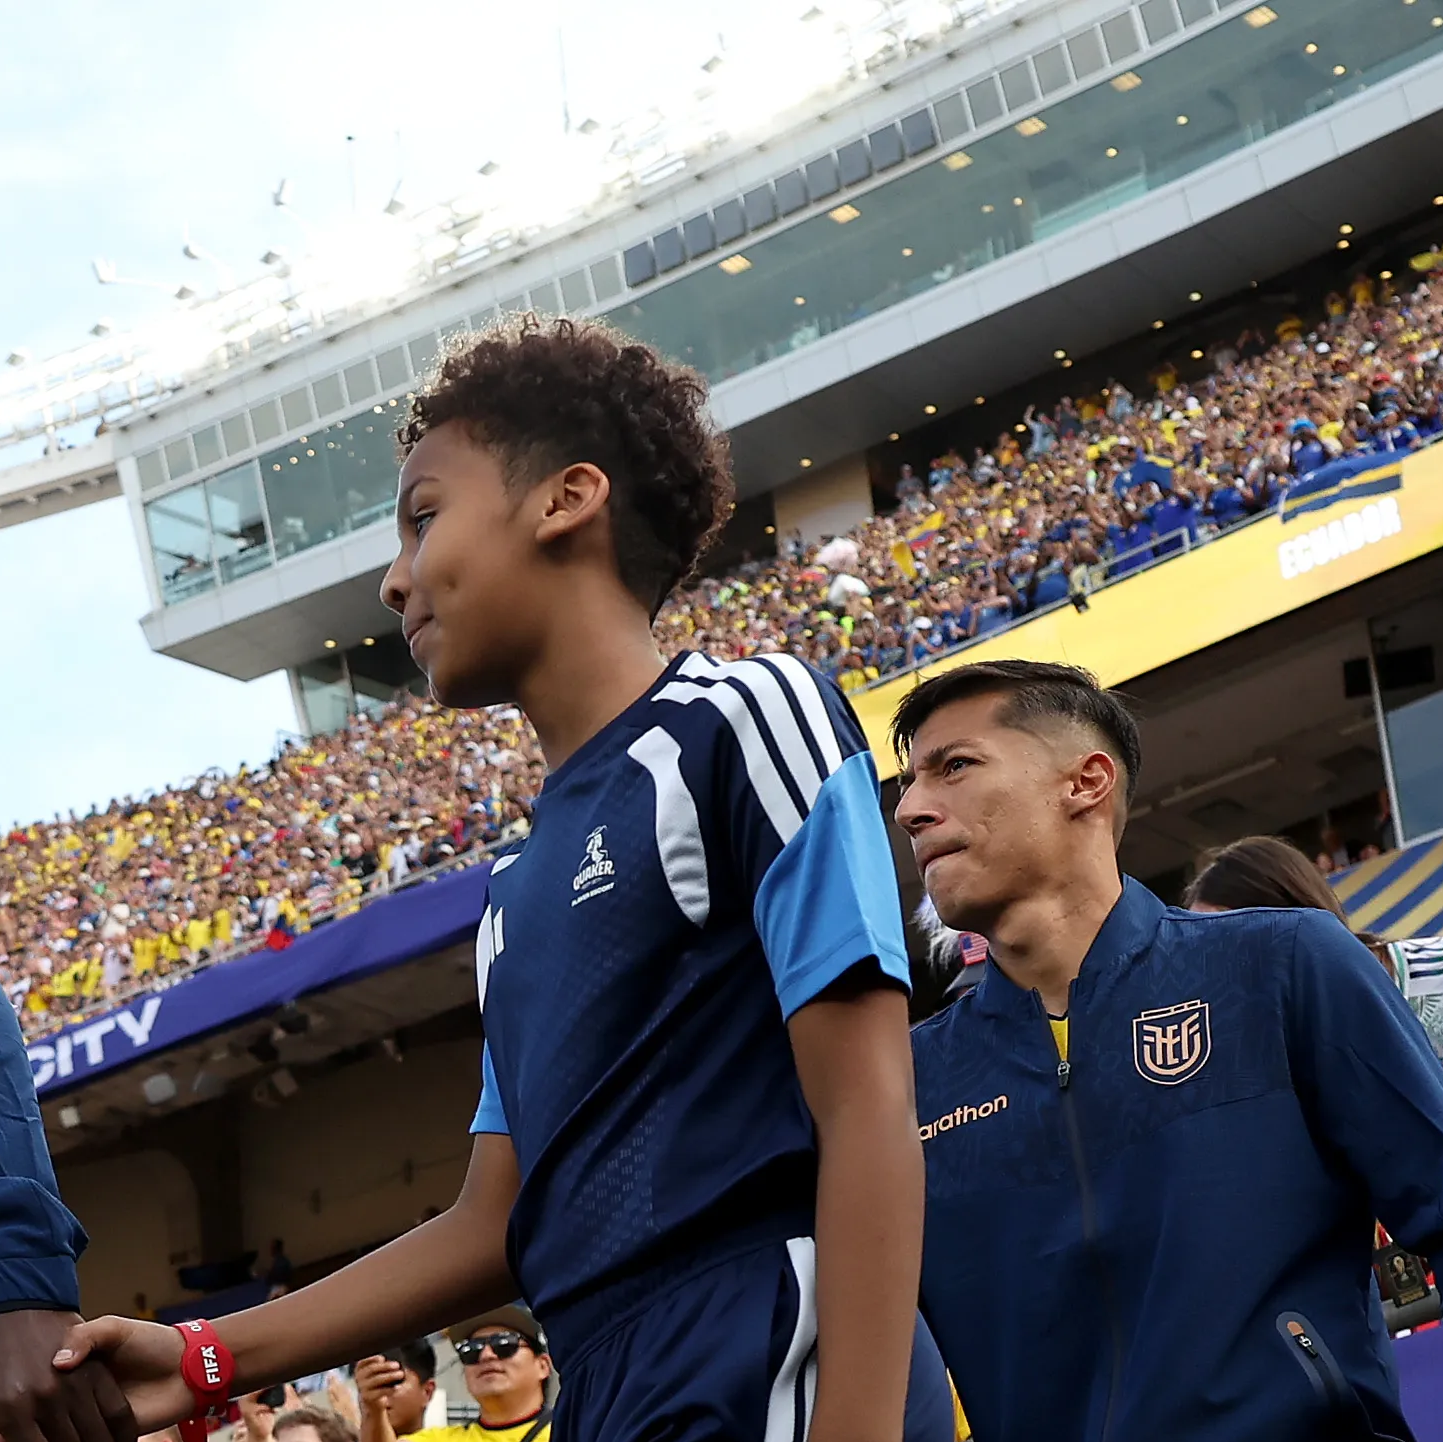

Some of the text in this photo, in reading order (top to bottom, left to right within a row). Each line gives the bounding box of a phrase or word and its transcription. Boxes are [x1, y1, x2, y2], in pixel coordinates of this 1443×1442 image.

[1278, 496, 1402, 579] ECUADOR
[573, 859, 615, 891] QUAKER
[27, 996, 162, 1088] CITY
[200, 1345, 221, 1384] FIFA
